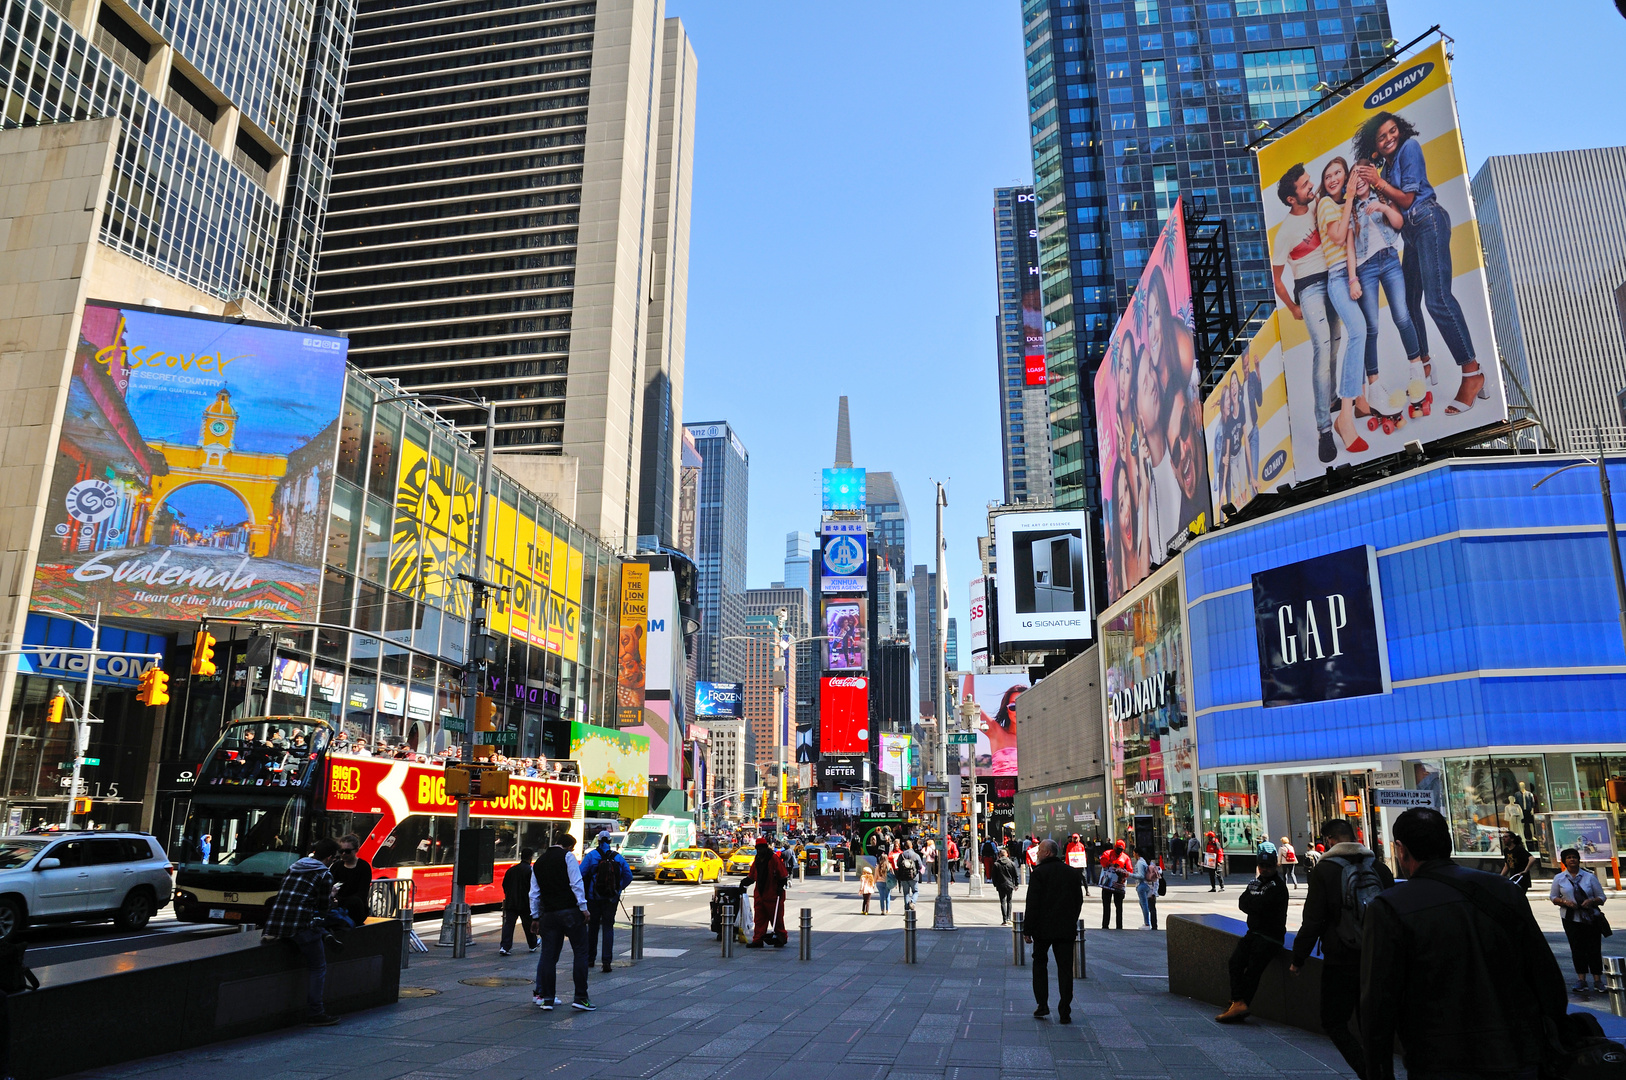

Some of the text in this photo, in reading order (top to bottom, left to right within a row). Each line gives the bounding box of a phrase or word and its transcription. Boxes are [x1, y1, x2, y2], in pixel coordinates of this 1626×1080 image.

[1371, 66, 1425, 105] OLD NAVY
[94, 317, 256, 376] discover
[120, 368, 222, 388] THE SECRET COUNTRY
[138, 384, 167, 392] ANTIGUA
[169, 387, 207, 396] GUATEMALA
[1264, 453, 1284, 478] OLD NAVY
[681, 485, 694, 547] TIMES
[527, 542, 549, 575] THE
[73, 550, 257, 592] Guatemala
[133, 591, 288, 611] Heart of the Mayan World
[625, 590, 644, 601] LION
[538, 580, 574, 633] KING
[623, 602, 646, 615] KING
[1277, 594, 1347, 665] GAP
[709, 690, 741, 702] FROZEN
[1113, 671, 1165, 722] OLD NAVY
[445, 717, 465, 732] Broadway
[485, 733, 493, 743] W
[497, 733, 507, 743] 44
[332, 765, 349, 779] BIG
[332, 780, 348, 792] BUS
[418, 775, 446, 805] BIG
[530, 786, 553, 811] USA
[1136, 779, 1159, 794] OLD NAVY
